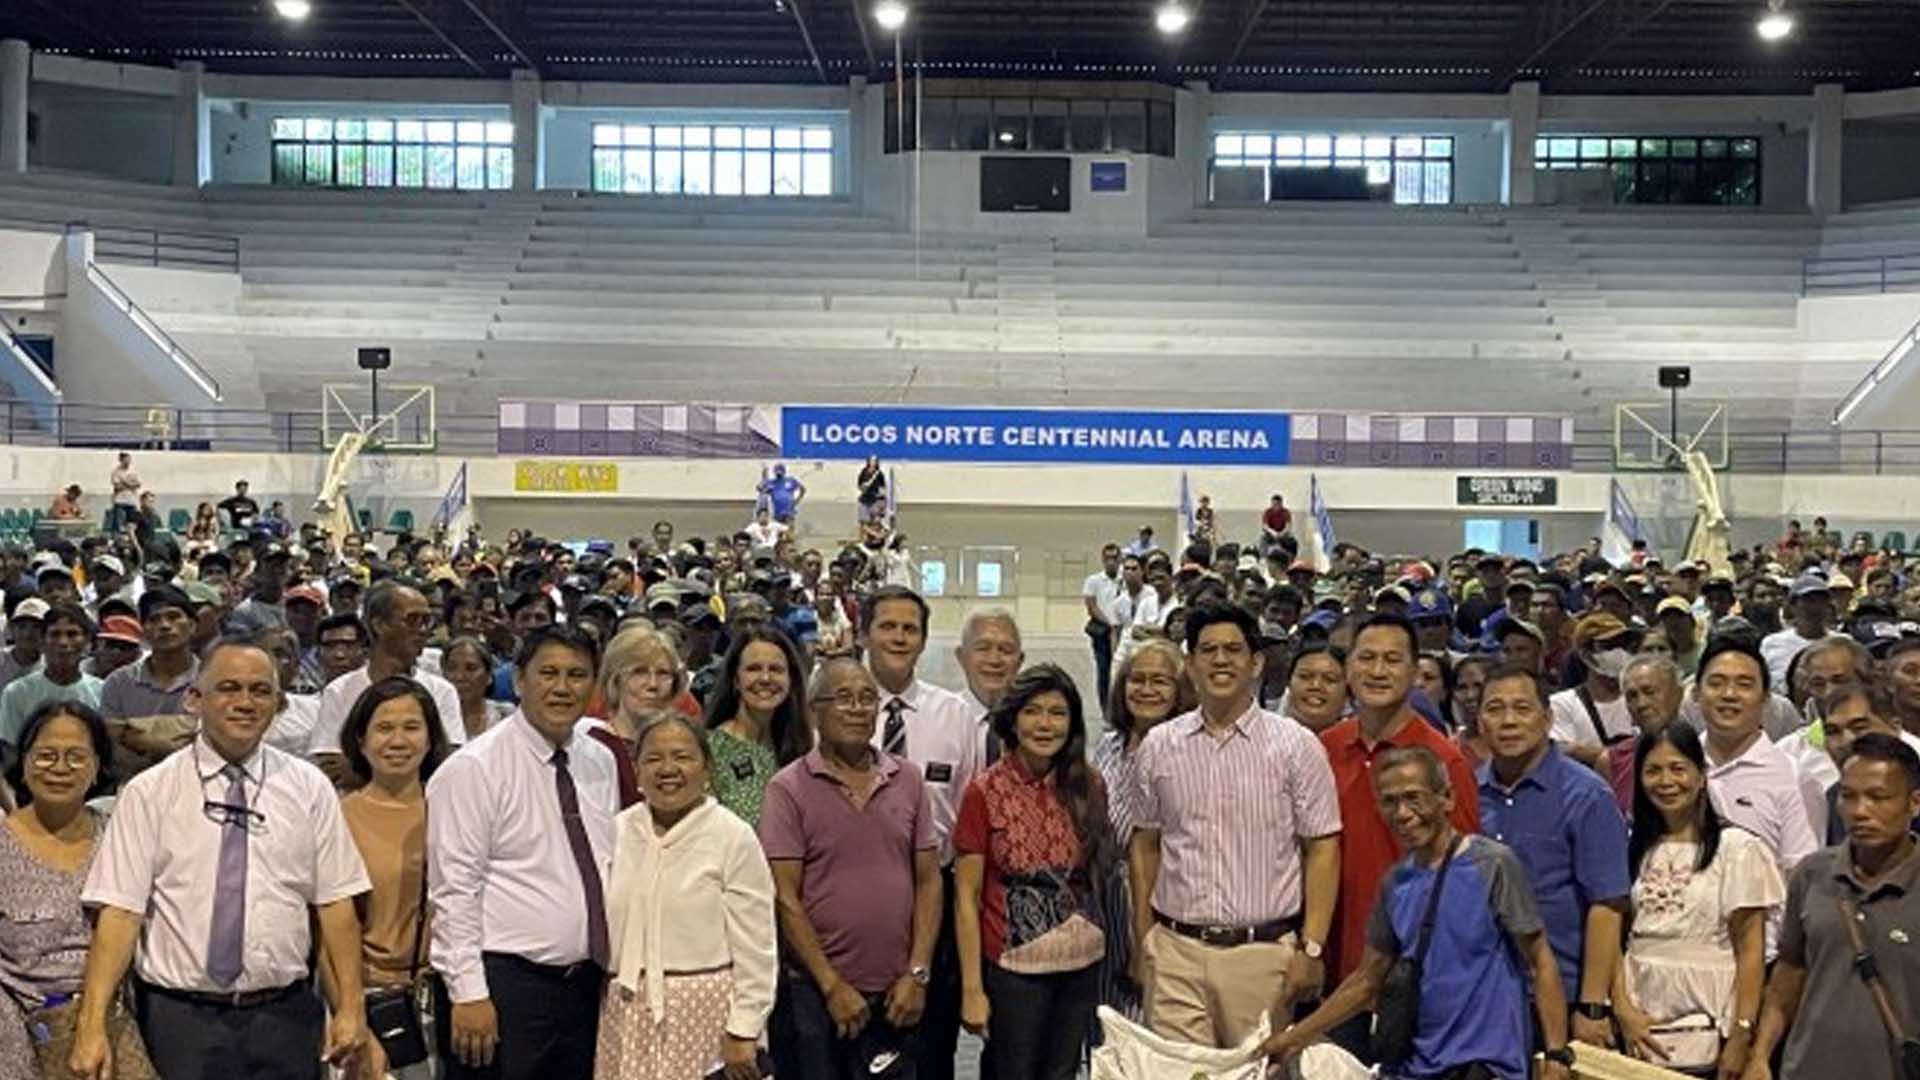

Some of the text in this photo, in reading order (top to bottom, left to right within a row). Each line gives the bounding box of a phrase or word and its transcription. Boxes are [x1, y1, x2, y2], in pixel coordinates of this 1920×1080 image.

[801, 424, 1269, 449] ILOCOS NORTE CENTENNIAL ARENA
